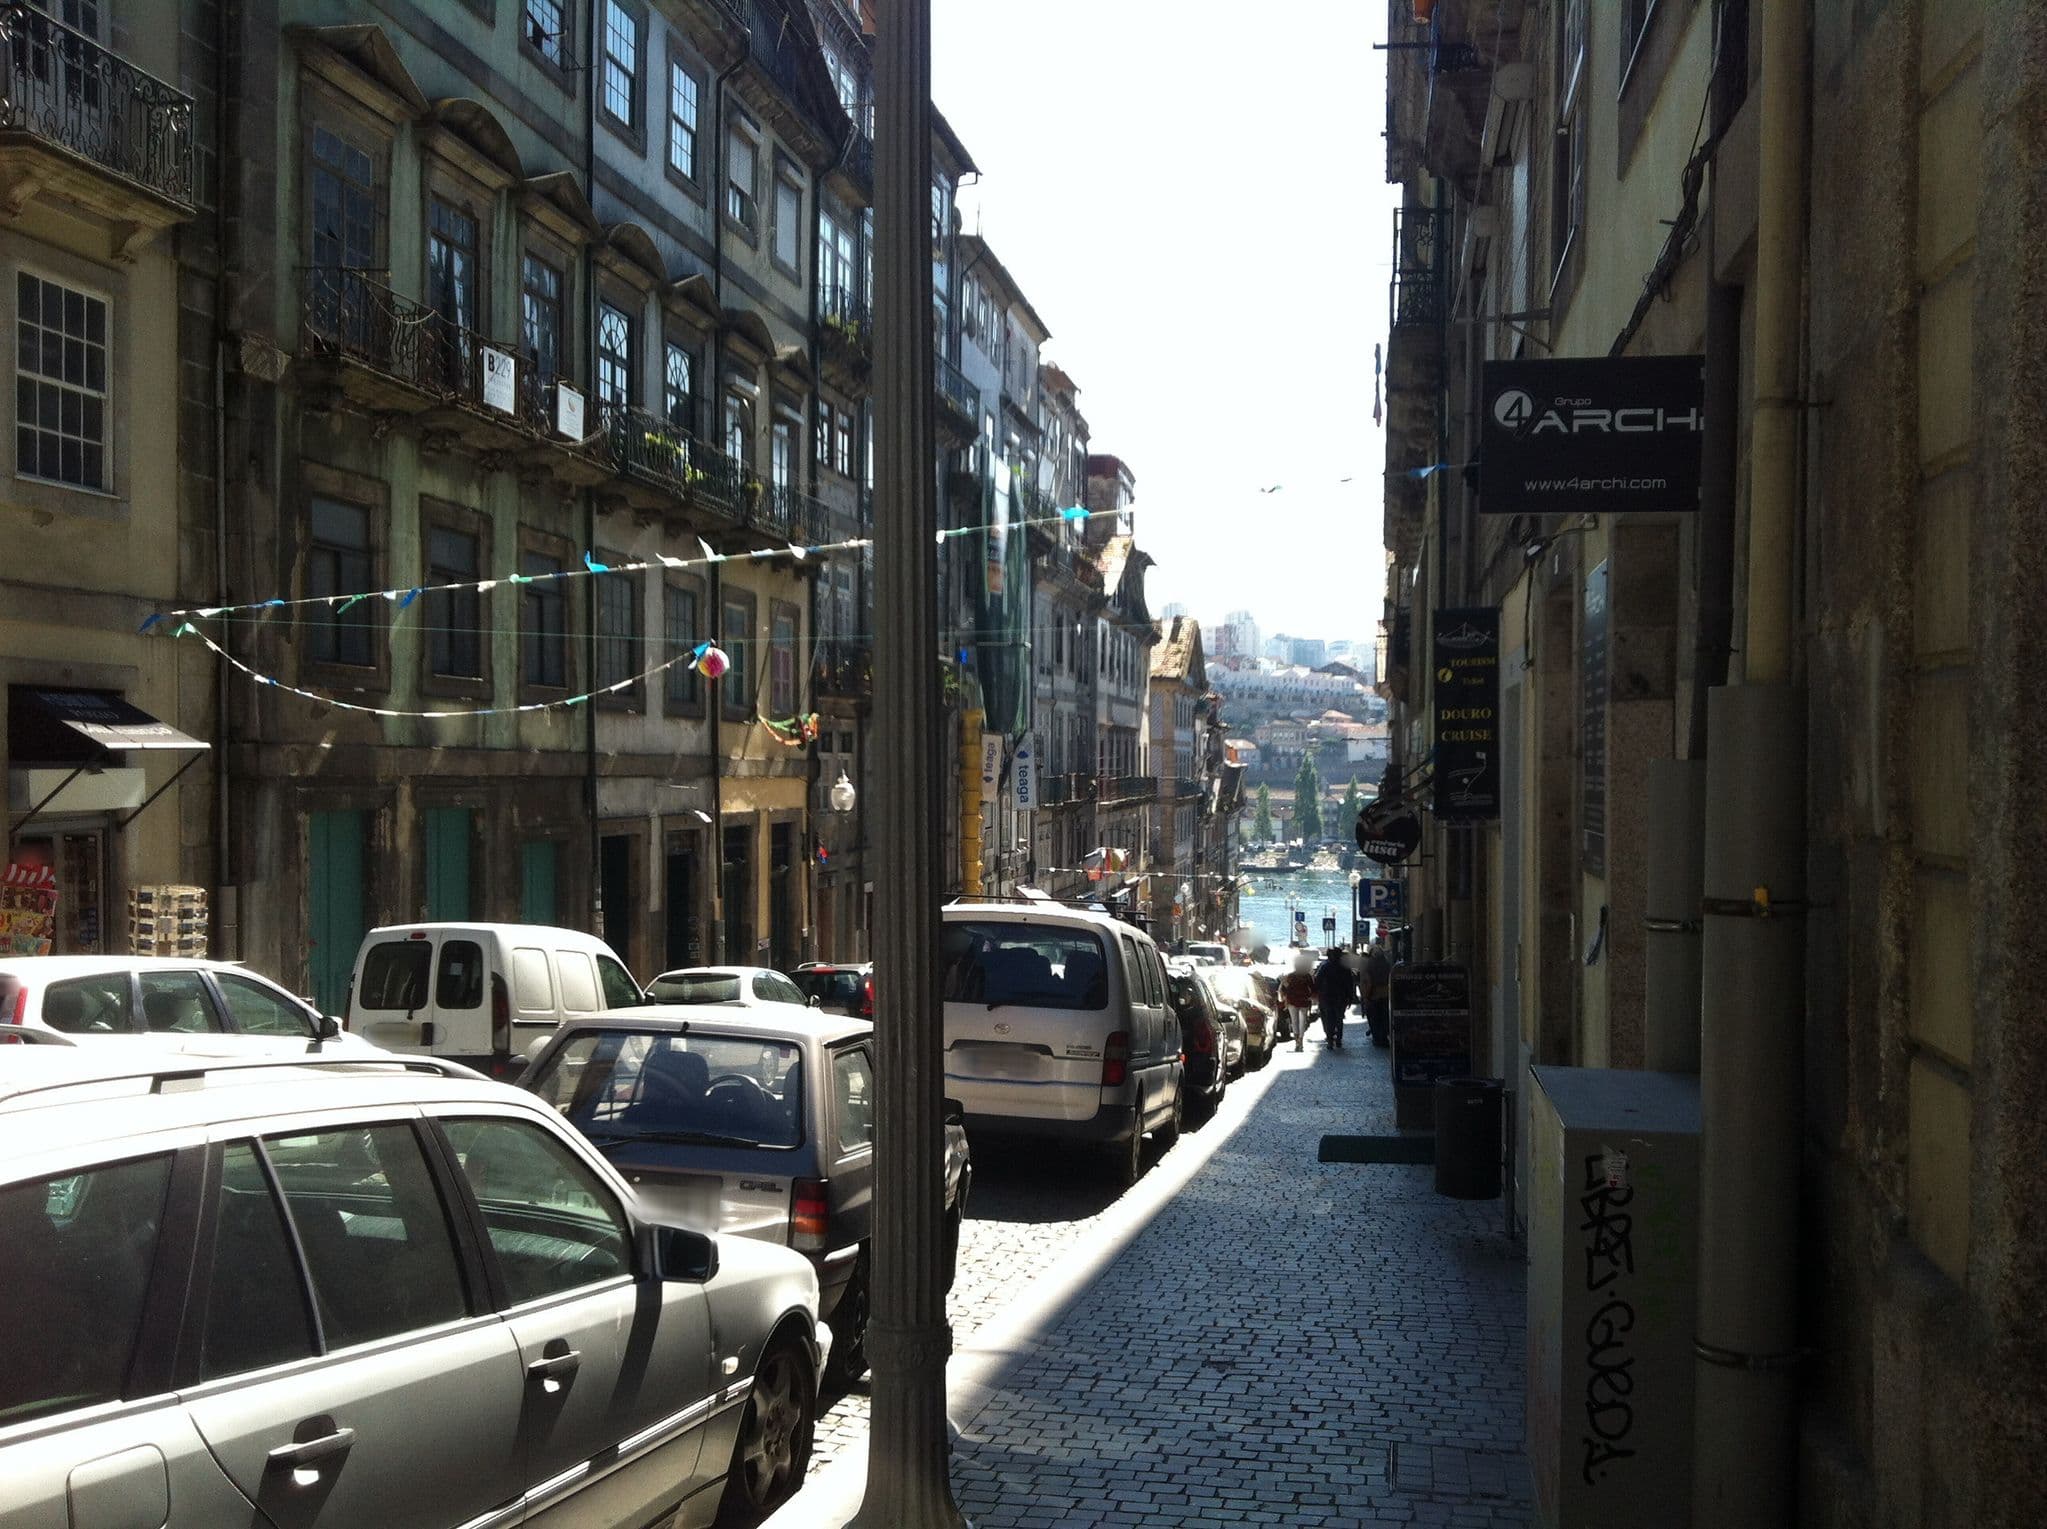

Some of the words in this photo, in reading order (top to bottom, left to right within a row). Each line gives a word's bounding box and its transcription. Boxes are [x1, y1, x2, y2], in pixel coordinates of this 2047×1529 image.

[1554, 396, 1593, 407] Grupo
[1524, 475, 1667, 491] www.4archi.com
[1441, 708, 1492, 721] DOURO
[1440, 729, 1492, 743] CRUISE
[1016, 765, 1029, 804] teaga
[1370, 885, 1389, 908] P
[739, 1180, 783, 1192] OPEL
